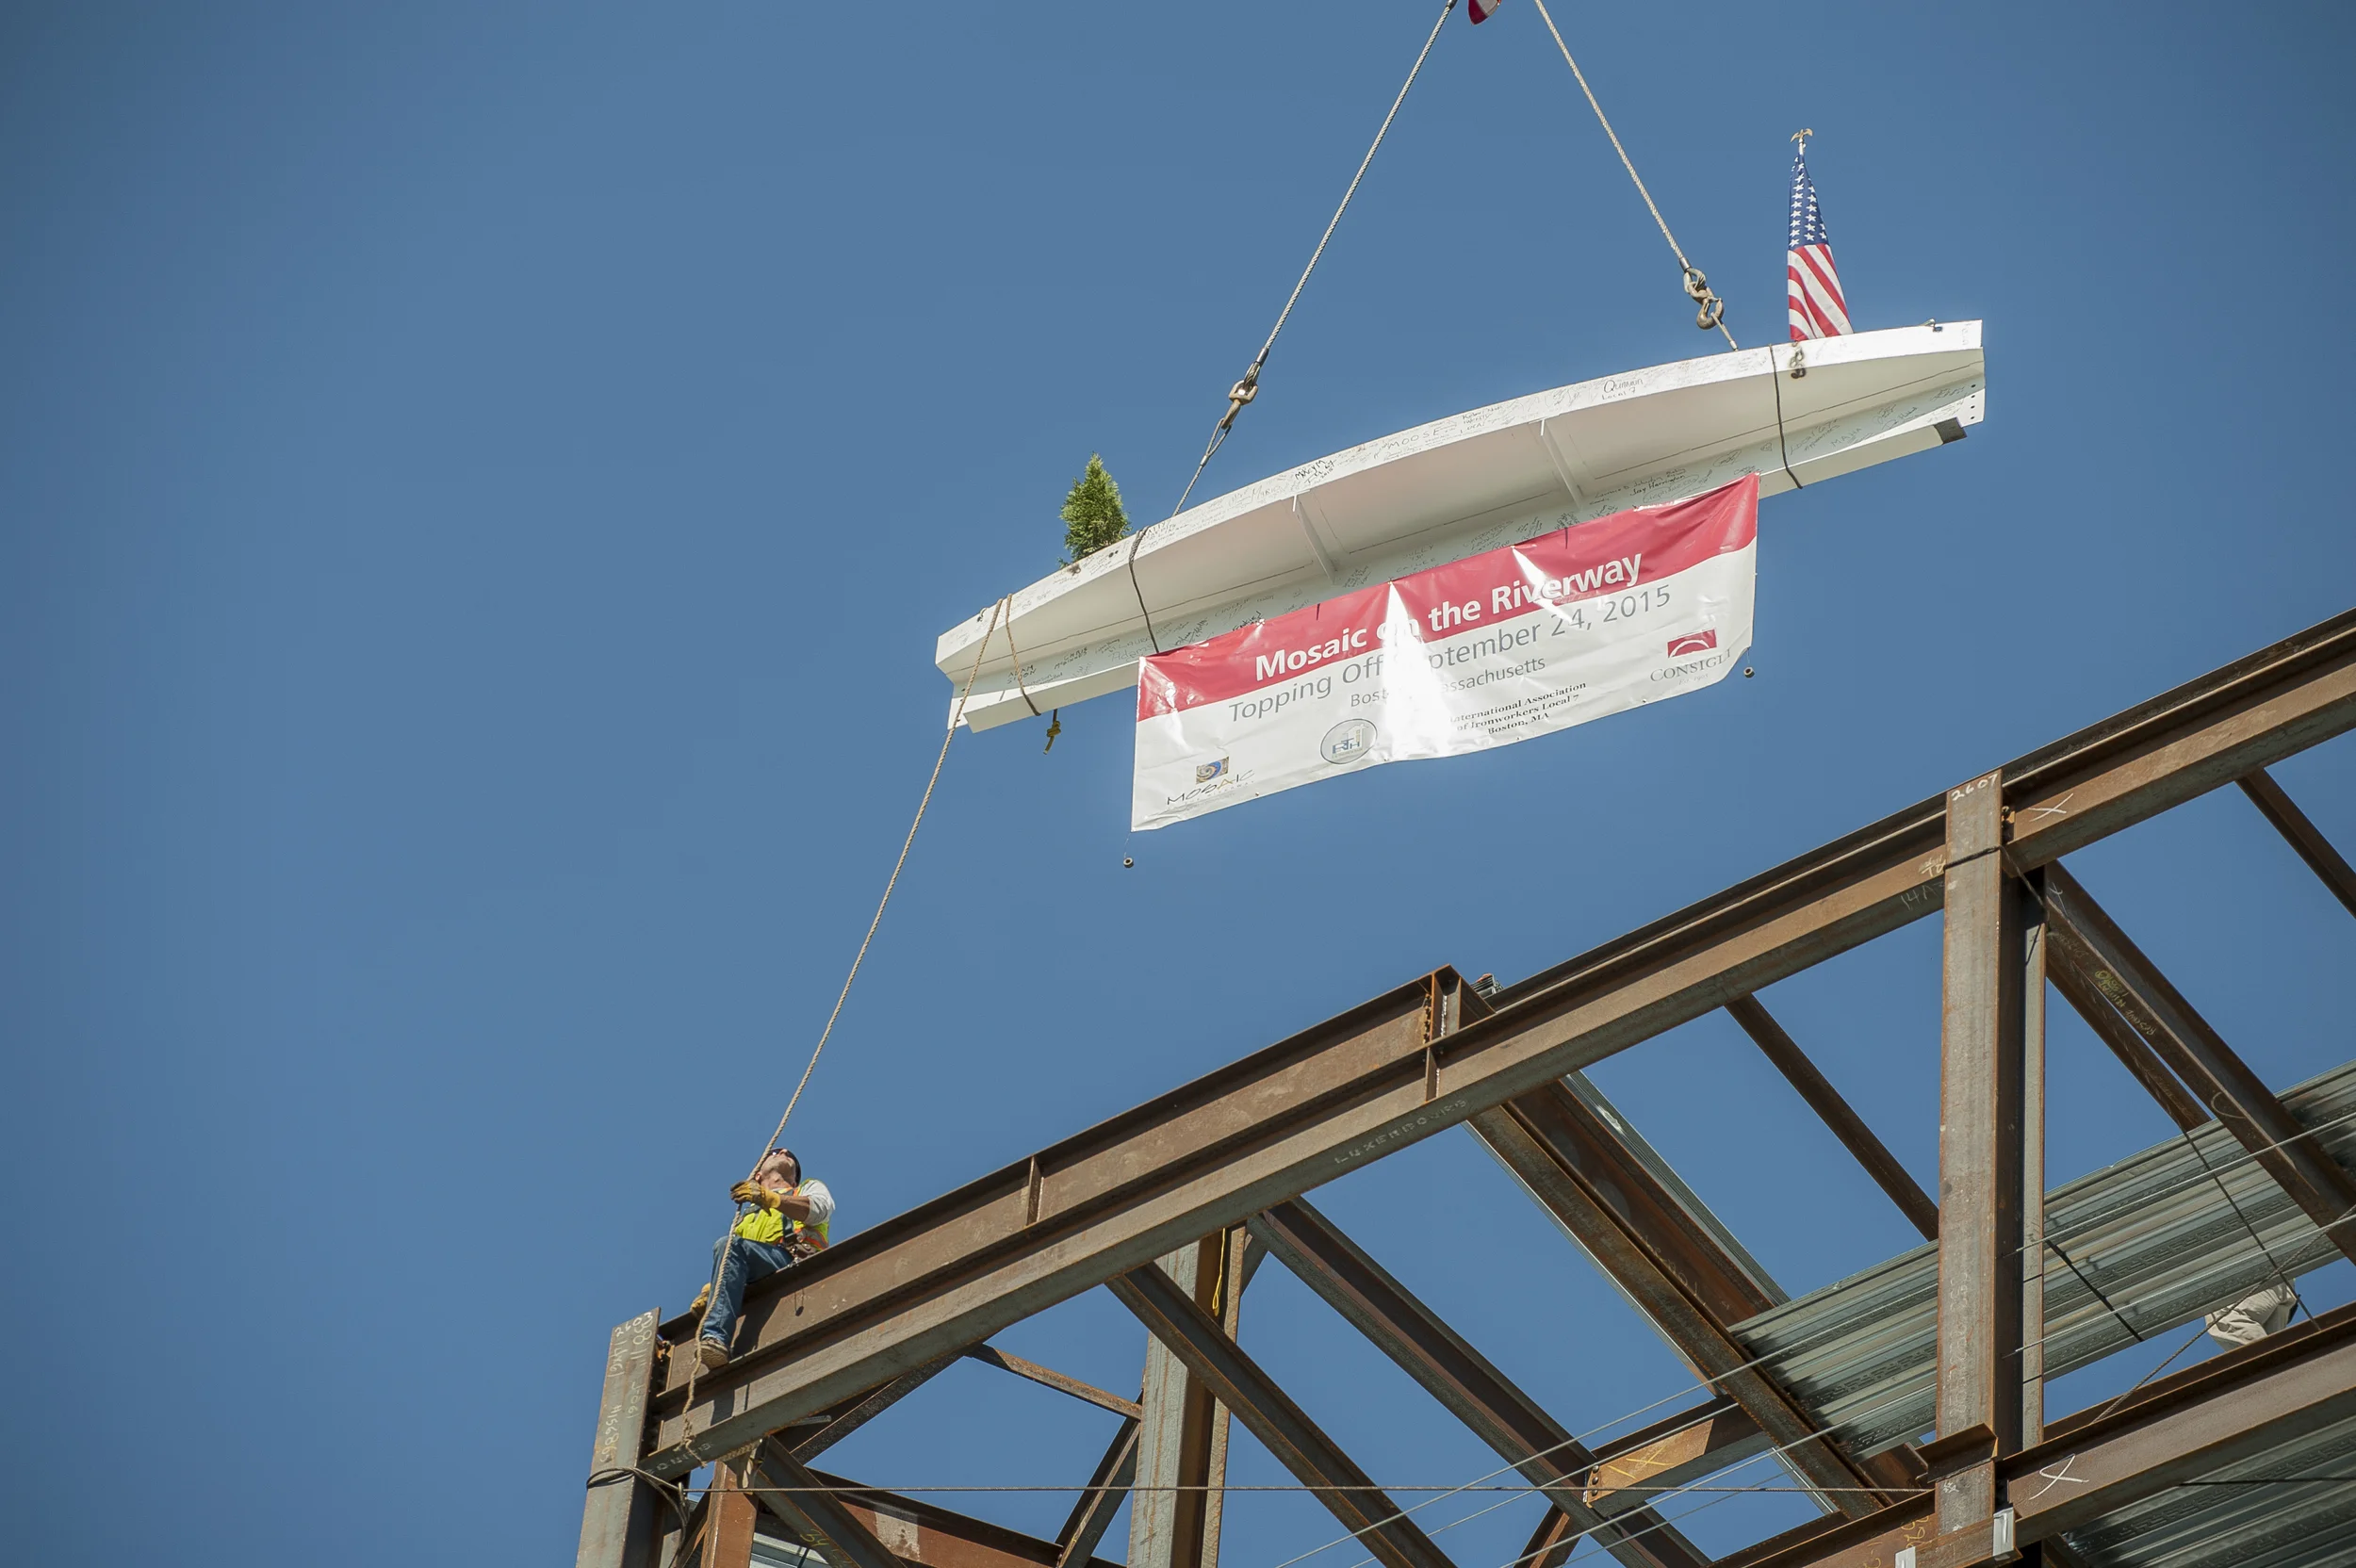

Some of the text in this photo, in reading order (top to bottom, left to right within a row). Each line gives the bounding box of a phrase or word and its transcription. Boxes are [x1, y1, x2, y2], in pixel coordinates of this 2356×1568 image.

[1255, 628, 1367, 681] Mosaic
[1428, 600, 1481, 632] the
[1492, 553, 1642, 615] Riverway
[1229, 676, 1332, 723] Topping
[1428, 623, 1542, 670] ptember
[1550, 608, 1592, 637] 24,
[1602, 583, 1671, 623] 2015
[1650, 648, 1731, 682] CONSIGLI
[1350, 657, 1546, 708] Bost assachusetts
[1524, 682, 1586, 706] Association
[1456, 694, 1580, 731] of Ironworkers Local 7
[1487, 712, 1550, 735] Boston, MA
[1167, 769, 1255, 805] MOSAIC
